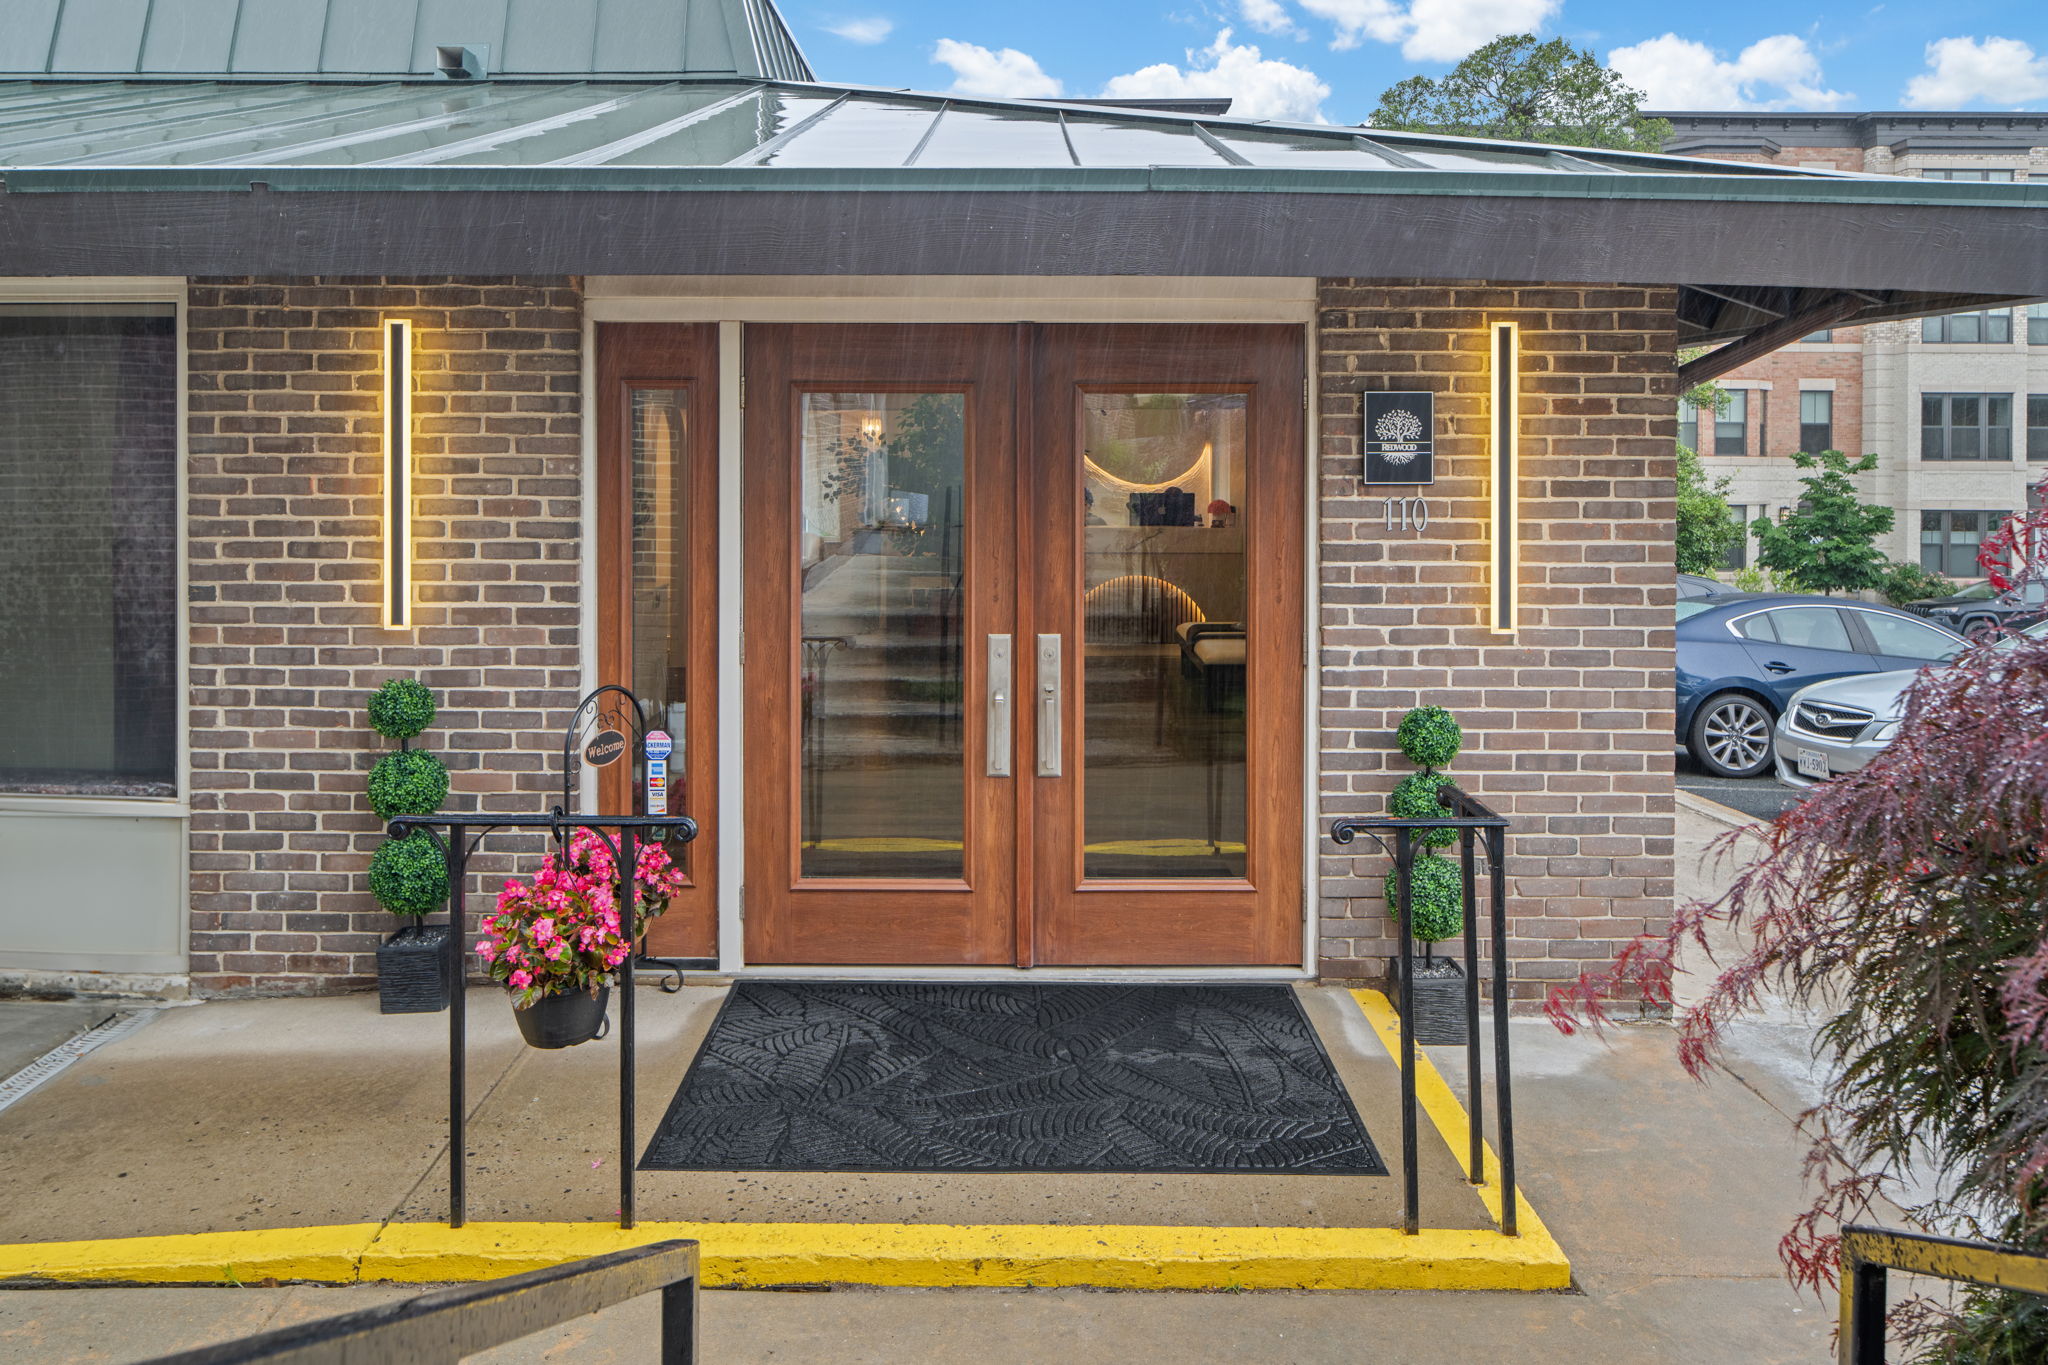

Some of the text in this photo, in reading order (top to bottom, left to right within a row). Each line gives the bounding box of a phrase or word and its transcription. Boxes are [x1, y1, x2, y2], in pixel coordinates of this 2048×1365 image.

[1381, 443, 1417, 451] REDWOOD
[1383, 497, 1428, 532] 110
[588, 740, 625, 759] Welcome
